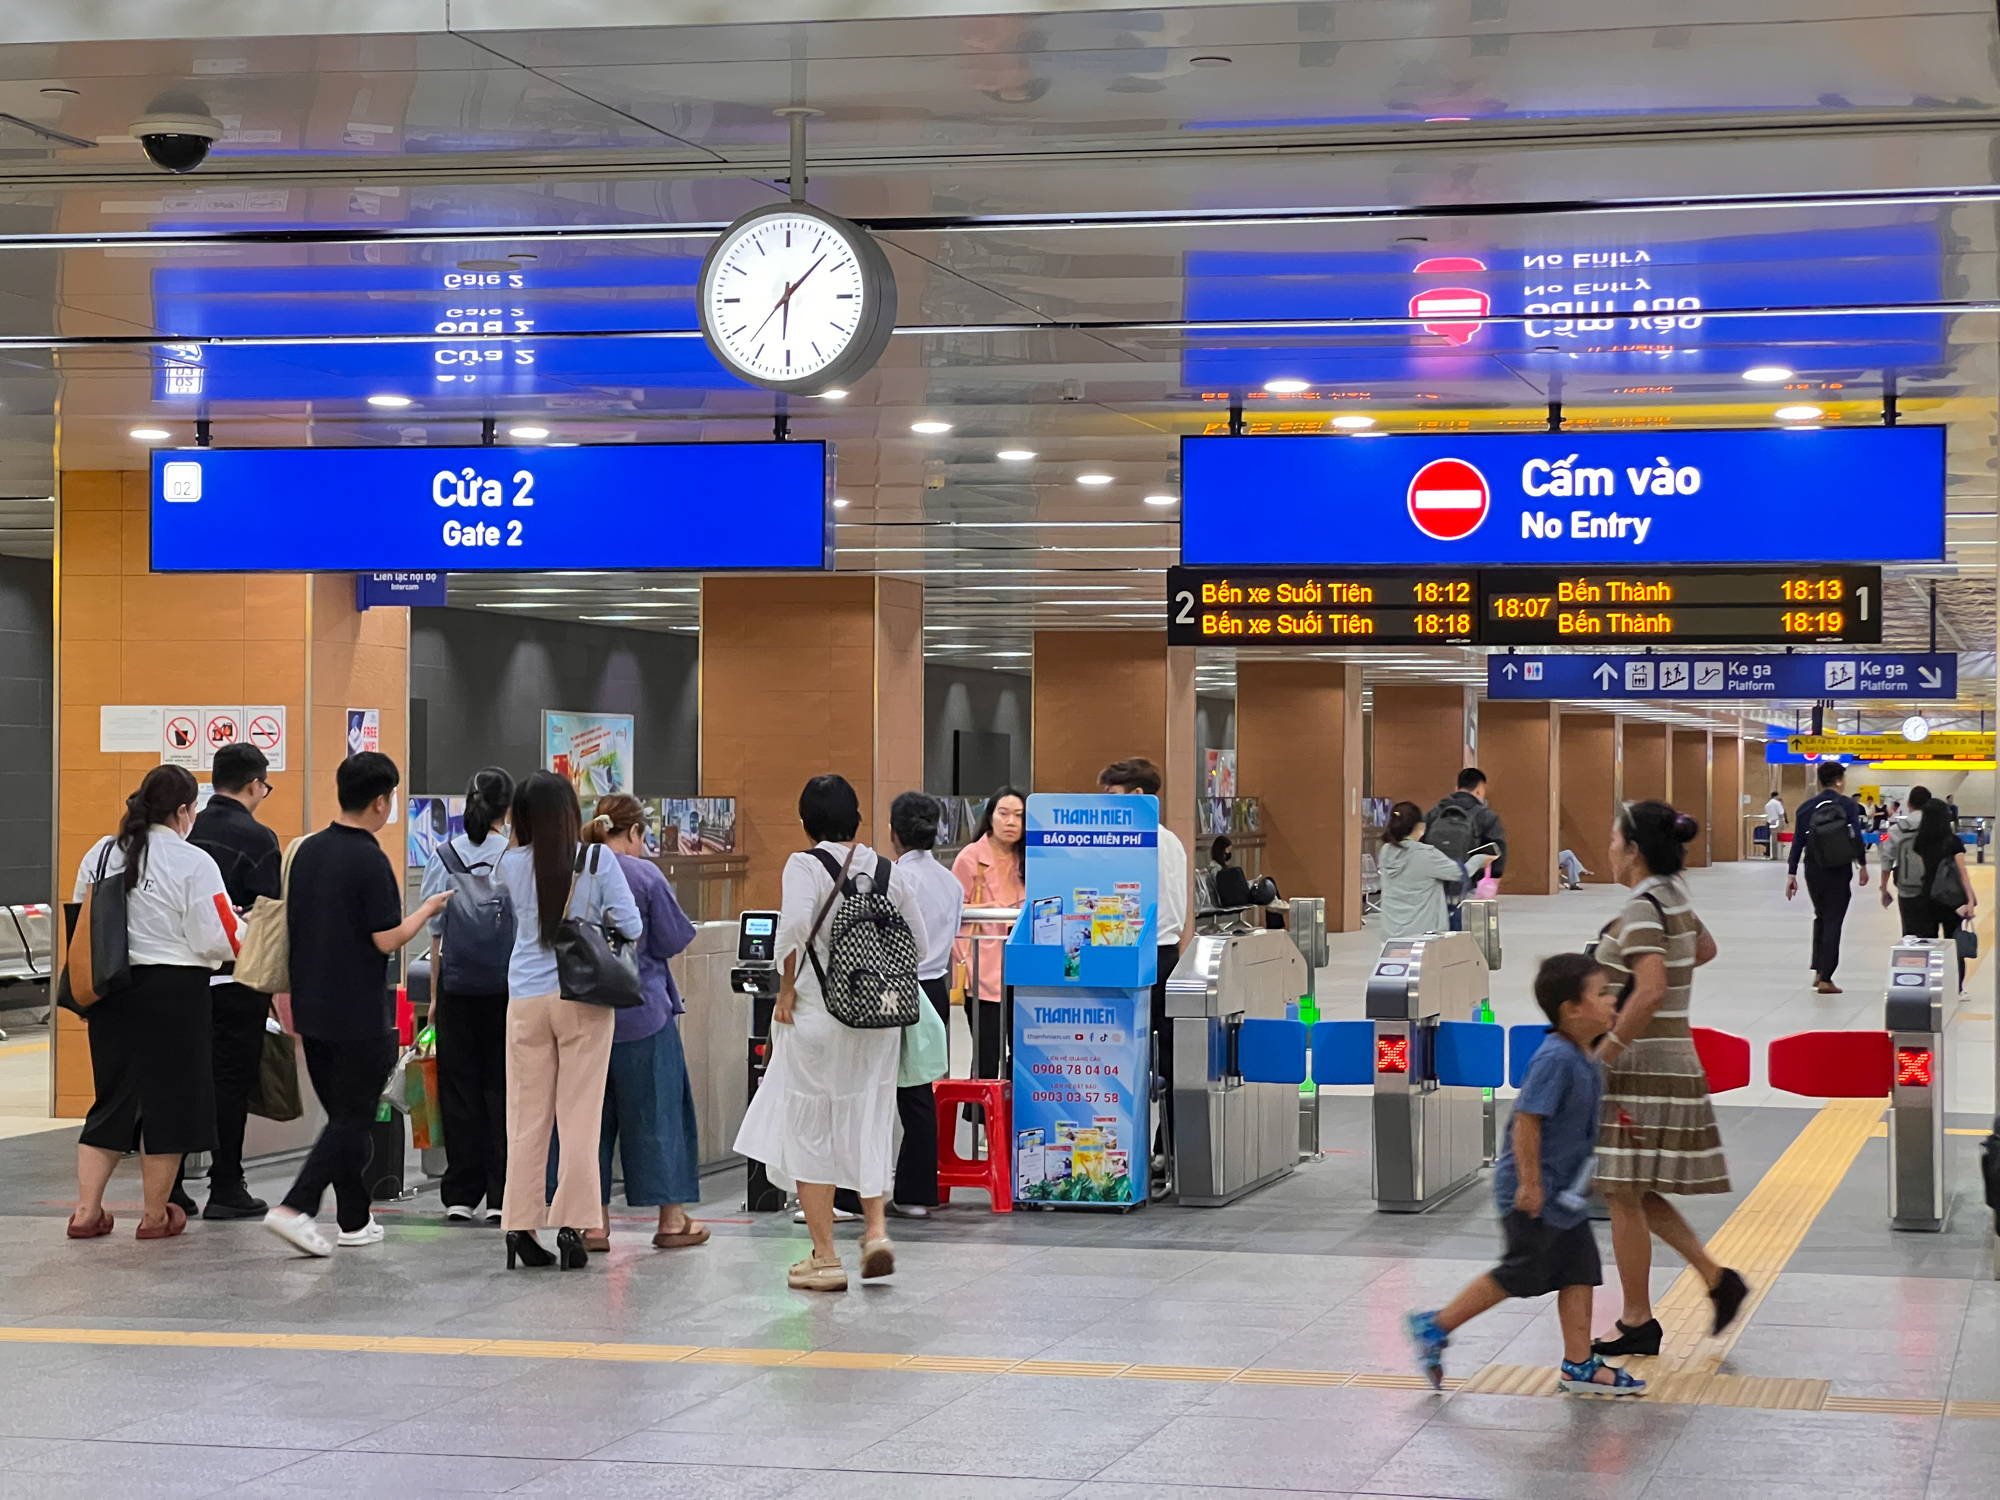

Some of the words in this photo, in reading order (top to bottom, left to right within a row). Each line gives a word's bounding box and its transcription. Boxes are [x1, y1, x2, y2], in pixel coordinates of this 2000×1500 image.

[1521, 453, 1614, 497] Cấm
[1626, 456, 1701, 496] vào
[173, 481, 191, 496] 02
[432, 467, 502, 507] Cửa
[512, 469, 534, 507] 2
[442, 520, 500, 547] Gate
[506, 520, 523, 546] 2
[1521, 511, 1563, 539] No
[1570, 511, 1651, 544] Entry
[1202, 580, 1242, 603] Bến
[1248, 586, 1271, 603] xe
[1276, 580, 1322, 603] Suối
[1328, 583, 1373, 603] Tiên
[1413, 582, 1471, 602] 18:12
[1558, 578, 1600, 602] Bến
[1606, 581, 1671, 602] Thành
[1781, 579, 1843, 600] 18:13
[1175, 590, 1195, 624] 2
[1494, 598, 1551, 618] 18:07
[1855, 586, 1869, 621] 1
[1202, 611, 1243, 634] Bến
[1248, 617, 1271, 634] xe
[1277, 611, 1322, 634] Suối
[1328, 614, 1373, 634] Tiên
[1413, 614, 1471, 634] 18:18
[1558, 609, 1600, 633] Bến
[1606, 612, 1671, 633] Thành
[1781, 611, 1843, 632] 18:19
[1728, 661, 1747, 676] Ke
[1753, 664, 1771, 680] ga
[1860, 661, 1880, 676] Ke
[1886, 664, 1905, 679] ga
[1728, 680, 1775, 690] Platform
[1860, 680, 1908, 691] Platform
[364, 726, 377, 738] FREE
[1052, 808, 1098, 825] THANH
[1043, 832, 1066, 844] BÁO
[1068, 834, 1090, 846] ĐỌC
[1122, 834, 1141, 845] PHÍ
[1034, 1007, 1081, 1024] THANH
[1032, 1064, 1062, 1074] 0908
[1066, 1064, 1082, 1075] 78
[1085, 1065, 1100, 1075] 04
[1104, 1066, 1118, 1076] 04
[1032, 1092, 1062, 1102] 0903
[1066, 1092, 1081, 1102] 03
[1085, 1092, 1100, 1102] 57
[1104, 1093, 1118, 1102] 58
